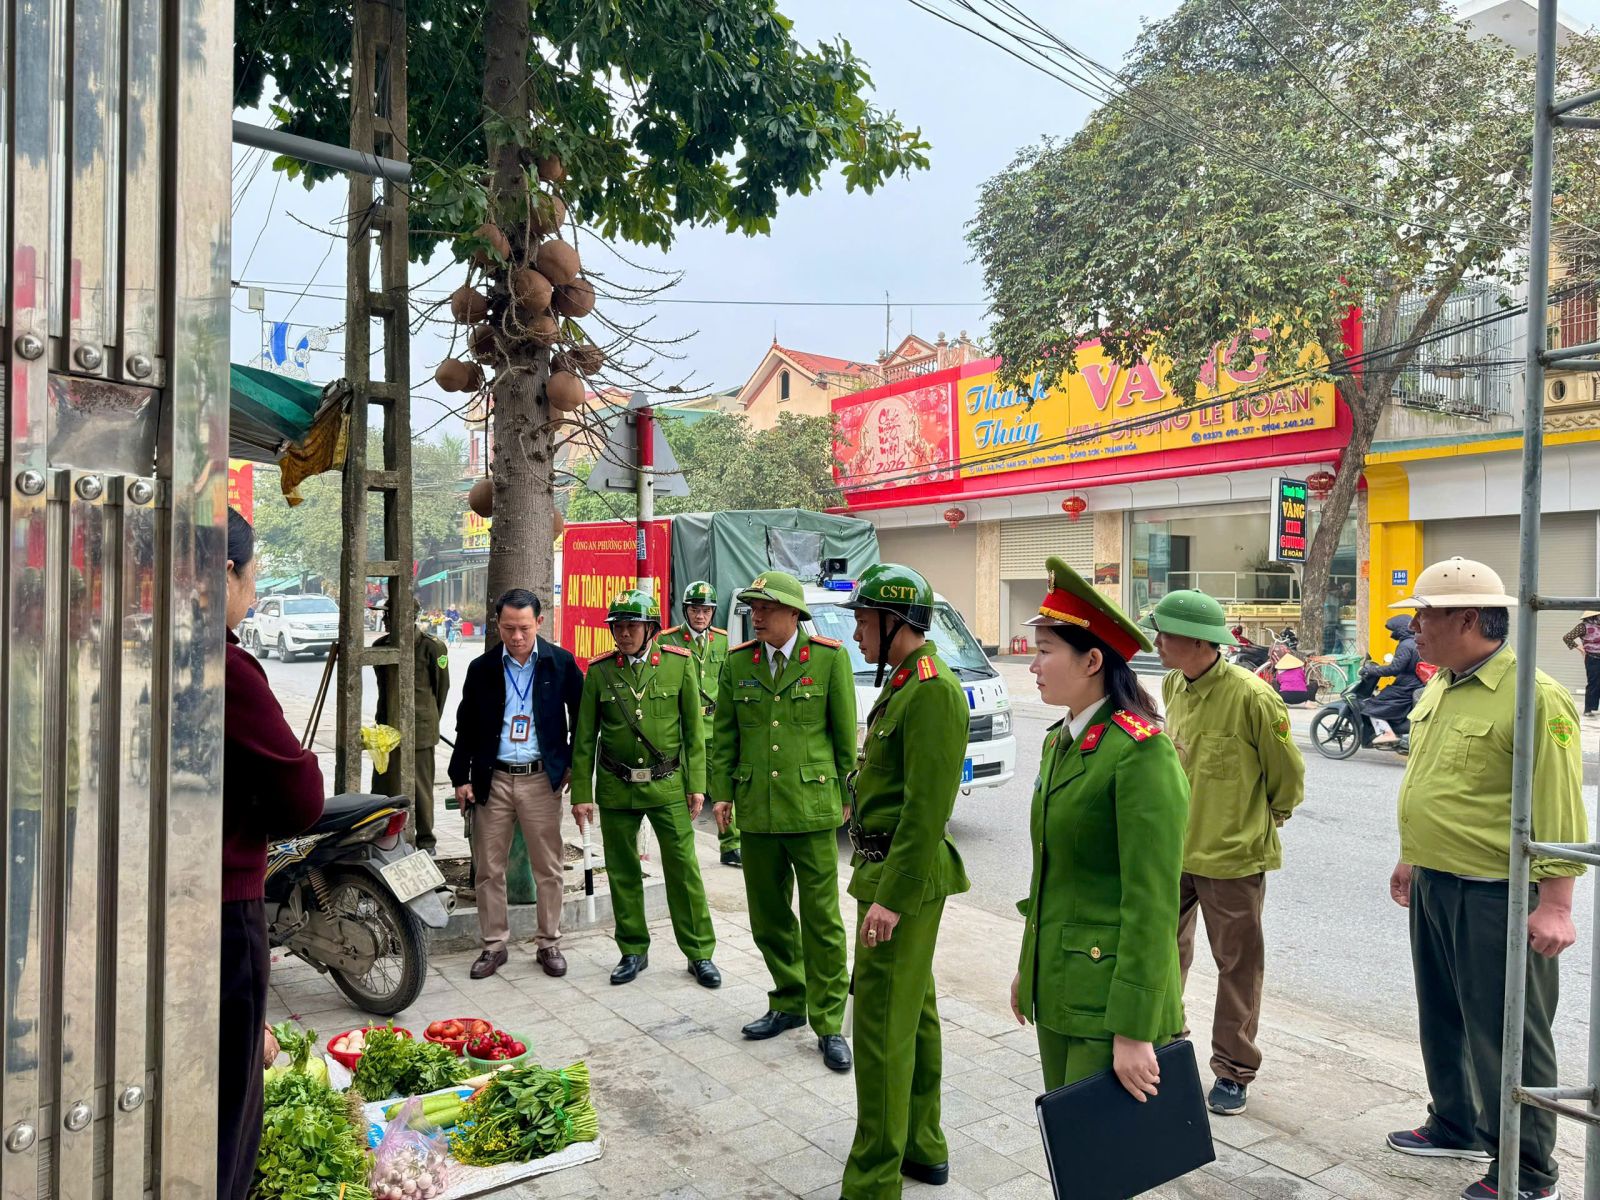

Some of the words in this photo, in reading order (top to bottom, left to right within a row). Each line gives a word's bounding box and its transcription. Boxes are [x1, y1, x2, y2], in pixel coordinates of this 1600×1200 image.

[1282, 498, 1306, 519] VÀNG
[588, 541, 598, 551] AN
[568, 574, 580, 607] AN
[581, 567, 604, 609] TOÀN
[880, 585, 917, 600] CSTT
[574, 618, 592, 659] VĂN
[400, 869, 437, 897] 0361
